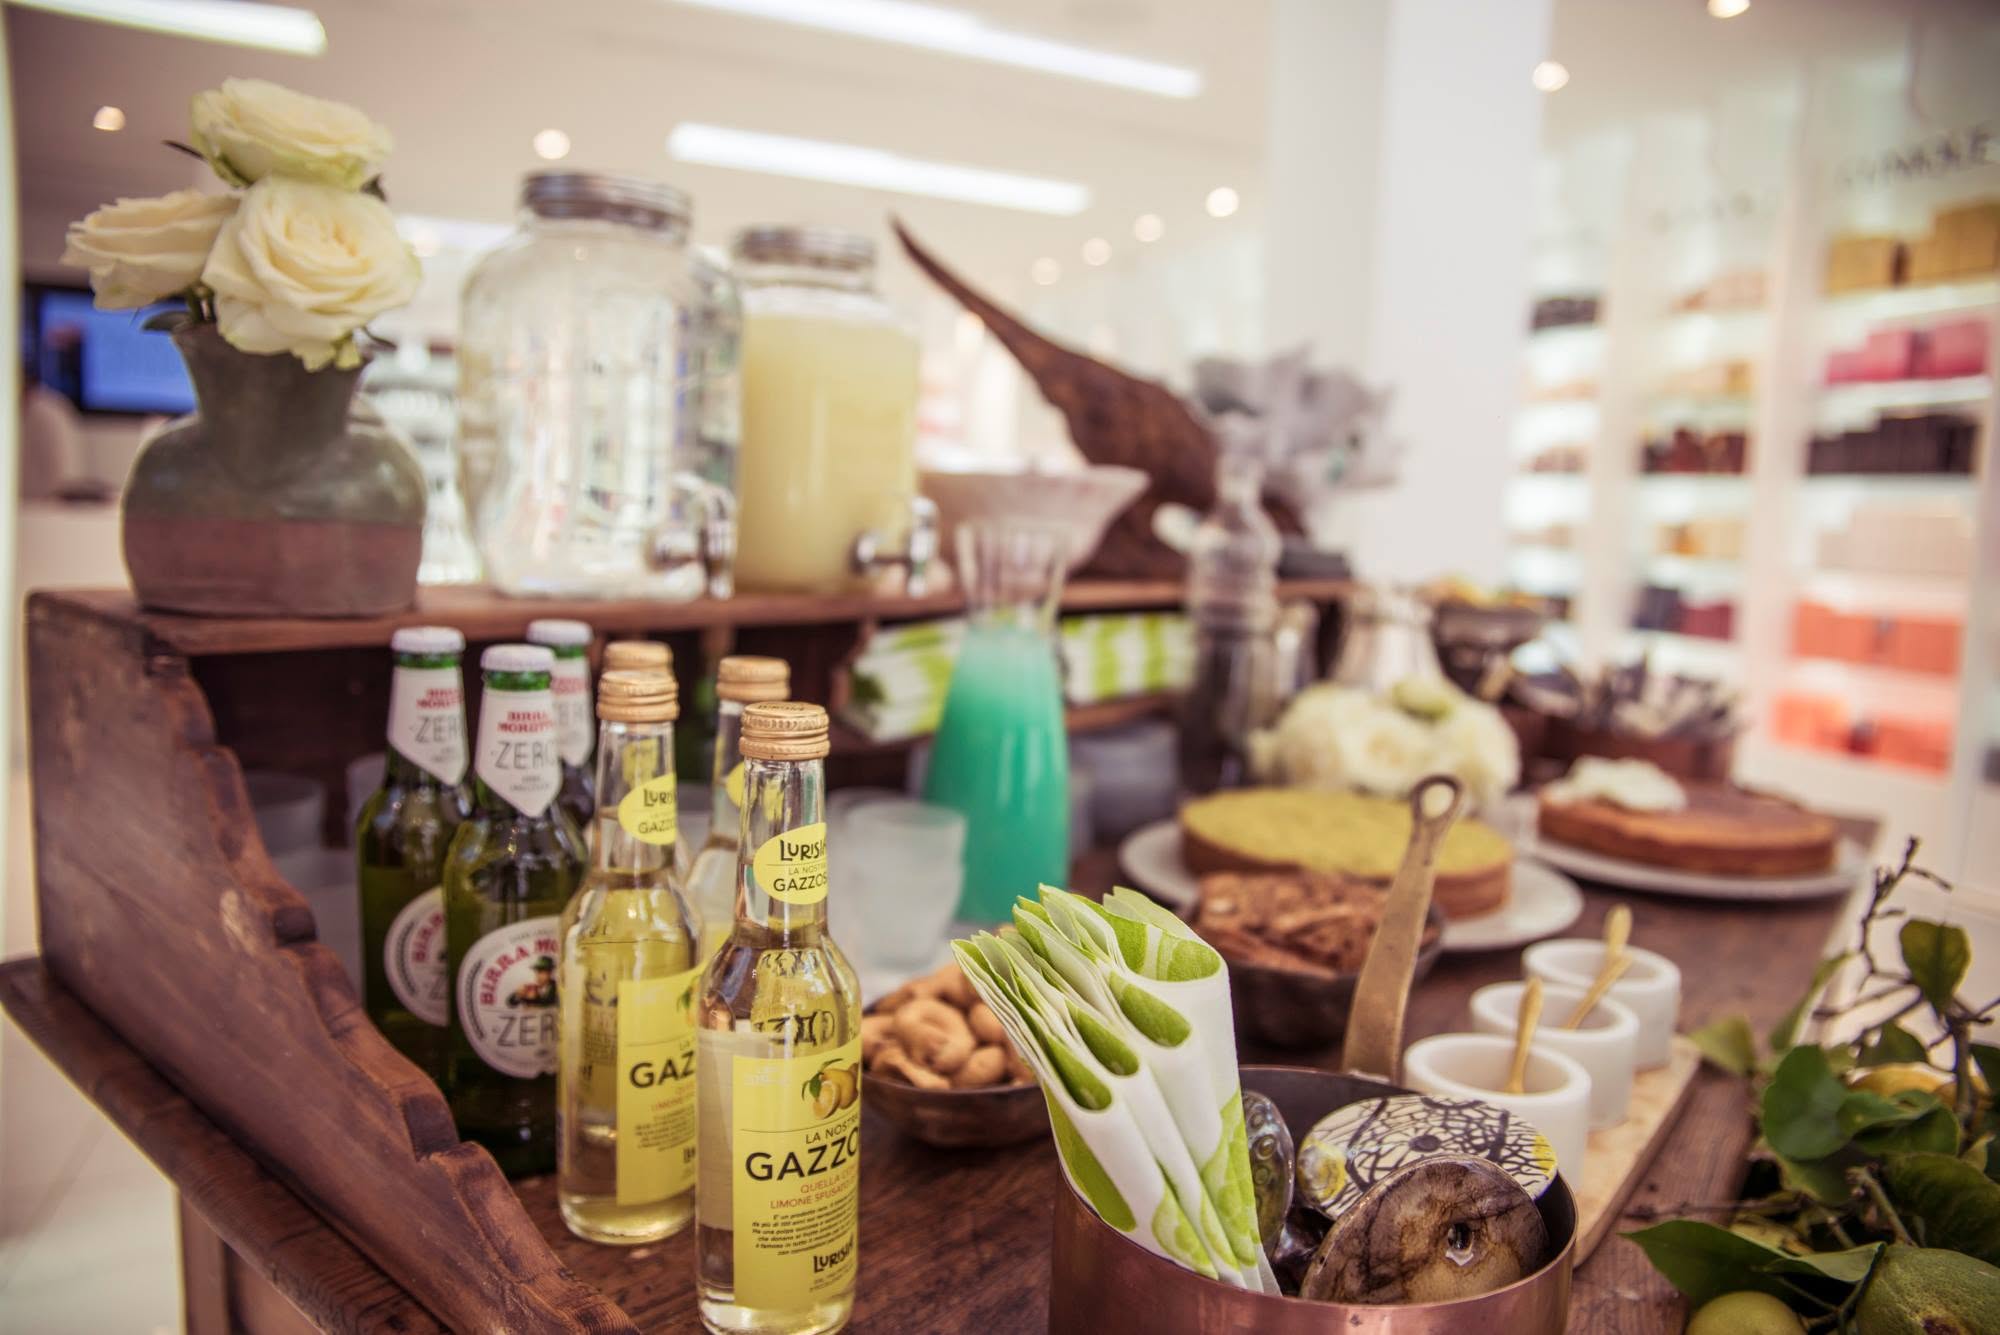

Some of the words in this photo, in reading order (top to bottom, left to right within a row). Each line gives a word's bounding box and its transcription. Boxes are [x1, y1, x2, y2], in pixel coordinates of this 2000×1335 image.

[480, 945, 530, 1006] BIRRA
[805, 1132, 822, 1145] LA
[769, 1195, 813, 1210] LIMONE
